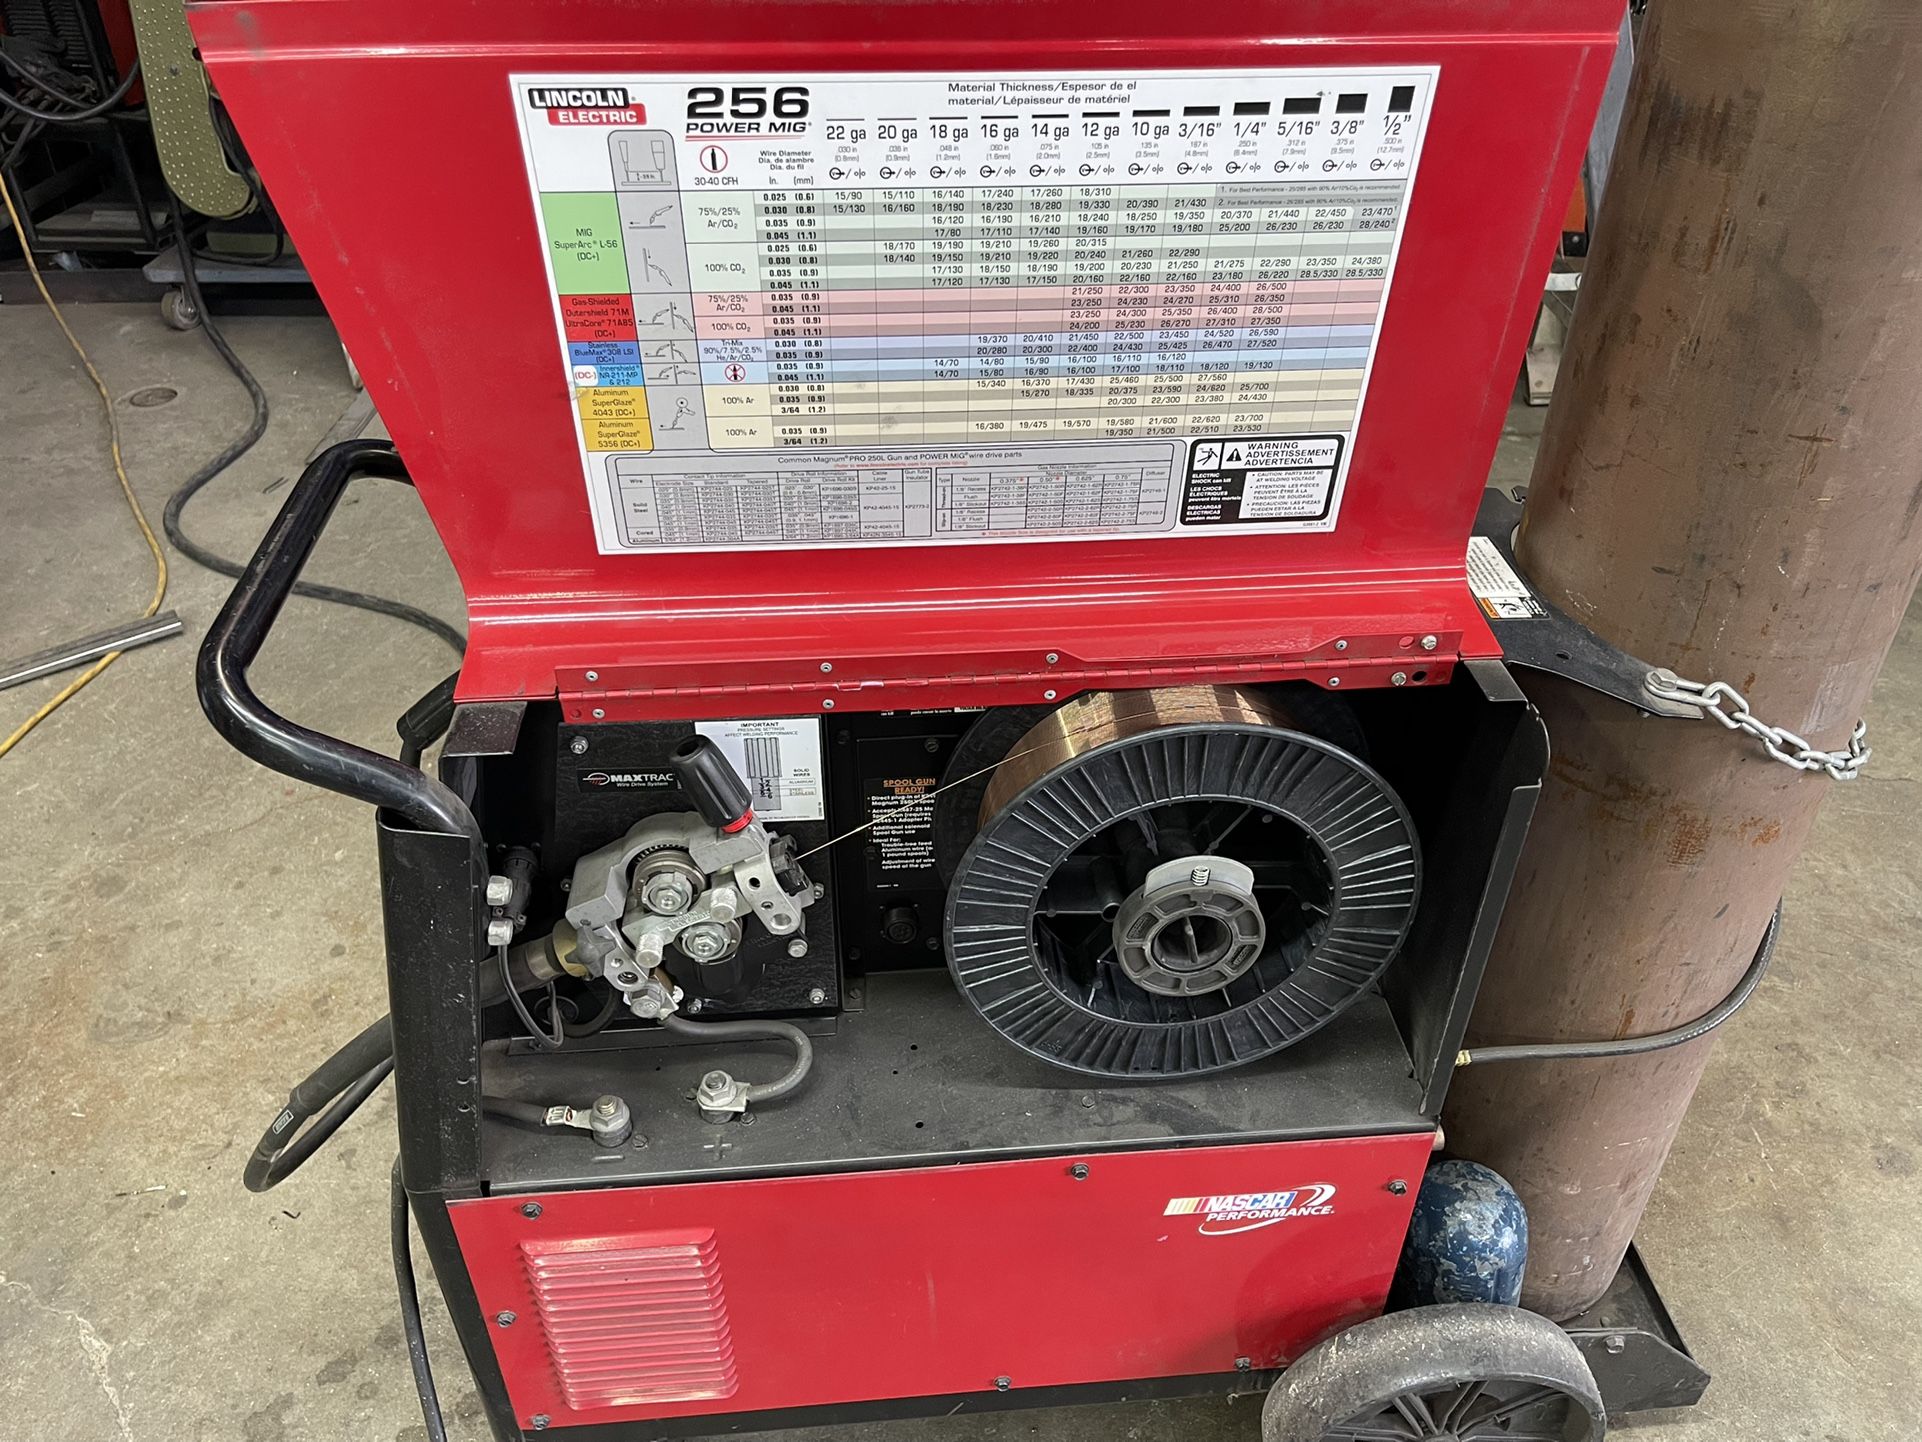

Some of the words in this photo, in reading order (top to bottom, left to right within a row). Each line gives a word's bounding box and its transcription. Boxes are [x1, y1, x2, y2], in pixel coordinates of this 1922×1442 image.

[948, 83, 996, 93] Material
[1000, 81, 1105, 93] Thickness/Espesor
[1109, 82, 1123, 91] de
[1127, 81, 1137, 90] el
[532, 88, 625, 107] LINCOLN
[948, 95, 1063, 106] material/Lépaisseur
[1068, 95, 1081, 105] de
[1085, 94, 1130, 106] matériel
[687, 86, 810, 119] 256
[558, 110, 637, 123] ELECTRIC
[685, 122, 761, 134] POWER
[826, 126, 846, 140] 22
[850, 129, 866, 143] ga
[878, 126, 897, 140] 20
[902, 129, 918, 143] ga
[929, 125, 948, 139] 18
[952, 128, 969, 142] ga
[981, 125, 999, 139] 16
[1003, 127, 1019, 141] ga
[1031, 124, 1049, 138] 14
[1054, 126, 1070, 141] ga
[1082, 123, 1099, 137] 12
[1104, 126, 1120, 140] ga
[1132, 122, 1148, 136] 10
[1153, 125, 1170, 139] ga
[694, 177, 719, 186] 30-40
[721, 177, 739, 186] CFH
[793, 176, 814, 186] (mm)
[763, 193, 787, 202] 0.025
[794, 192, 815, 202] (0.6)
[835, 190, 863, 201] 15/90
[932, 189, 965, 199] 16/140
[1030, 188, 1063, 198] 17/260
[1079, 187, 1112, 197] 18/310
[764, 206, 787, 215] 0.030
[795, 205, 815, 215] (0.8)
[832, 204, 866, 213] 15/130
[1079, 200, 1111, 210] 19/330
[1126, 199, 1159, 209] 20/390
[1174, 198, 1207, 208] 21/430
[699, 207, 740, 216] 75%/25%
[765, 219, 788, 228] 0.035
[796, 218, 816, 228] (0.9)
[1220, 209, 1253, 220] 20/370
[1315, 208, 1347, 218] 22/450
[576, 228, 593, 237] MIG
[766, 231, 789, 240] 0.045
[797, 231, 817, 240] (1.1)
[934, 227, 962, 238] 17/80
[1218, 222, 1251, 232] 25/200
[600, 240, 618, 248] L-56
[883, 241, 916, 251] 18/170
[1075, 238, 1107, 248] 20/315
[577, 252, 600, 261] (DC+)
[705, 264, 728, 273] 100%
[1345, 268, 1383, 278] 28.5/330
[1210, 282, 1242, 292] 24/400
[571, 298, 620, 306] Gas-Shielded
[708, 294, 749, 303] 75%/25%
[566, 309, 608, 317] Outershield
[610, 308, 629, 316] 71M
[711, 322, 734, 331] 100%
[595, 330, 615, 338] (DC+)
[977, 334, 1008, 344] 19/370
[1203, 329, 1235, 338] 24/520
[588, 341, 618, 349] Stainless
[1157, 352, 1187, 361] 16/120
[1244, 361, 1273, 370] 19/130
[575, 371, 597, 380] (DC-)
[1239, 382, 1270, 391] 25/700
[593, 388, 629, 396] Aluminum
[722, 396, 742, 405] 100%
[744, 396, 754, 405] Ar
[592, 409, 613, 417] 4043
[615, 408, 636, 417] (DC+)
[781, 405, 800, 414] 3/64
[808, 405, 826, 414] (1.2)
[1234, 413, 1264, 422] 23/700
[598, 420, 633, 428] Aluminum
[1232, 424, 1262, 433] 23/530
[725, 428, 745, 437] 100%
[747, 428, 757, 437] Ar
[620, 440, 640, 448] (DC+)
[1247, 442, 1299, 450] WARNING
[778, 456, 812, 464] Common
[920, 452, 949, 460] POWER
[1004, 451, 1023, 459] parts
[1245, 449, 1334, 459] ADVERTISSEMENT
[1244, 457, 1313, 466] ADVERTENCIA
[610, 773, 674, 782] MAXTRAC
[883, 779, 912, 787] SPOOL
[1204, 1192, 1290, 1212] NASCAR
